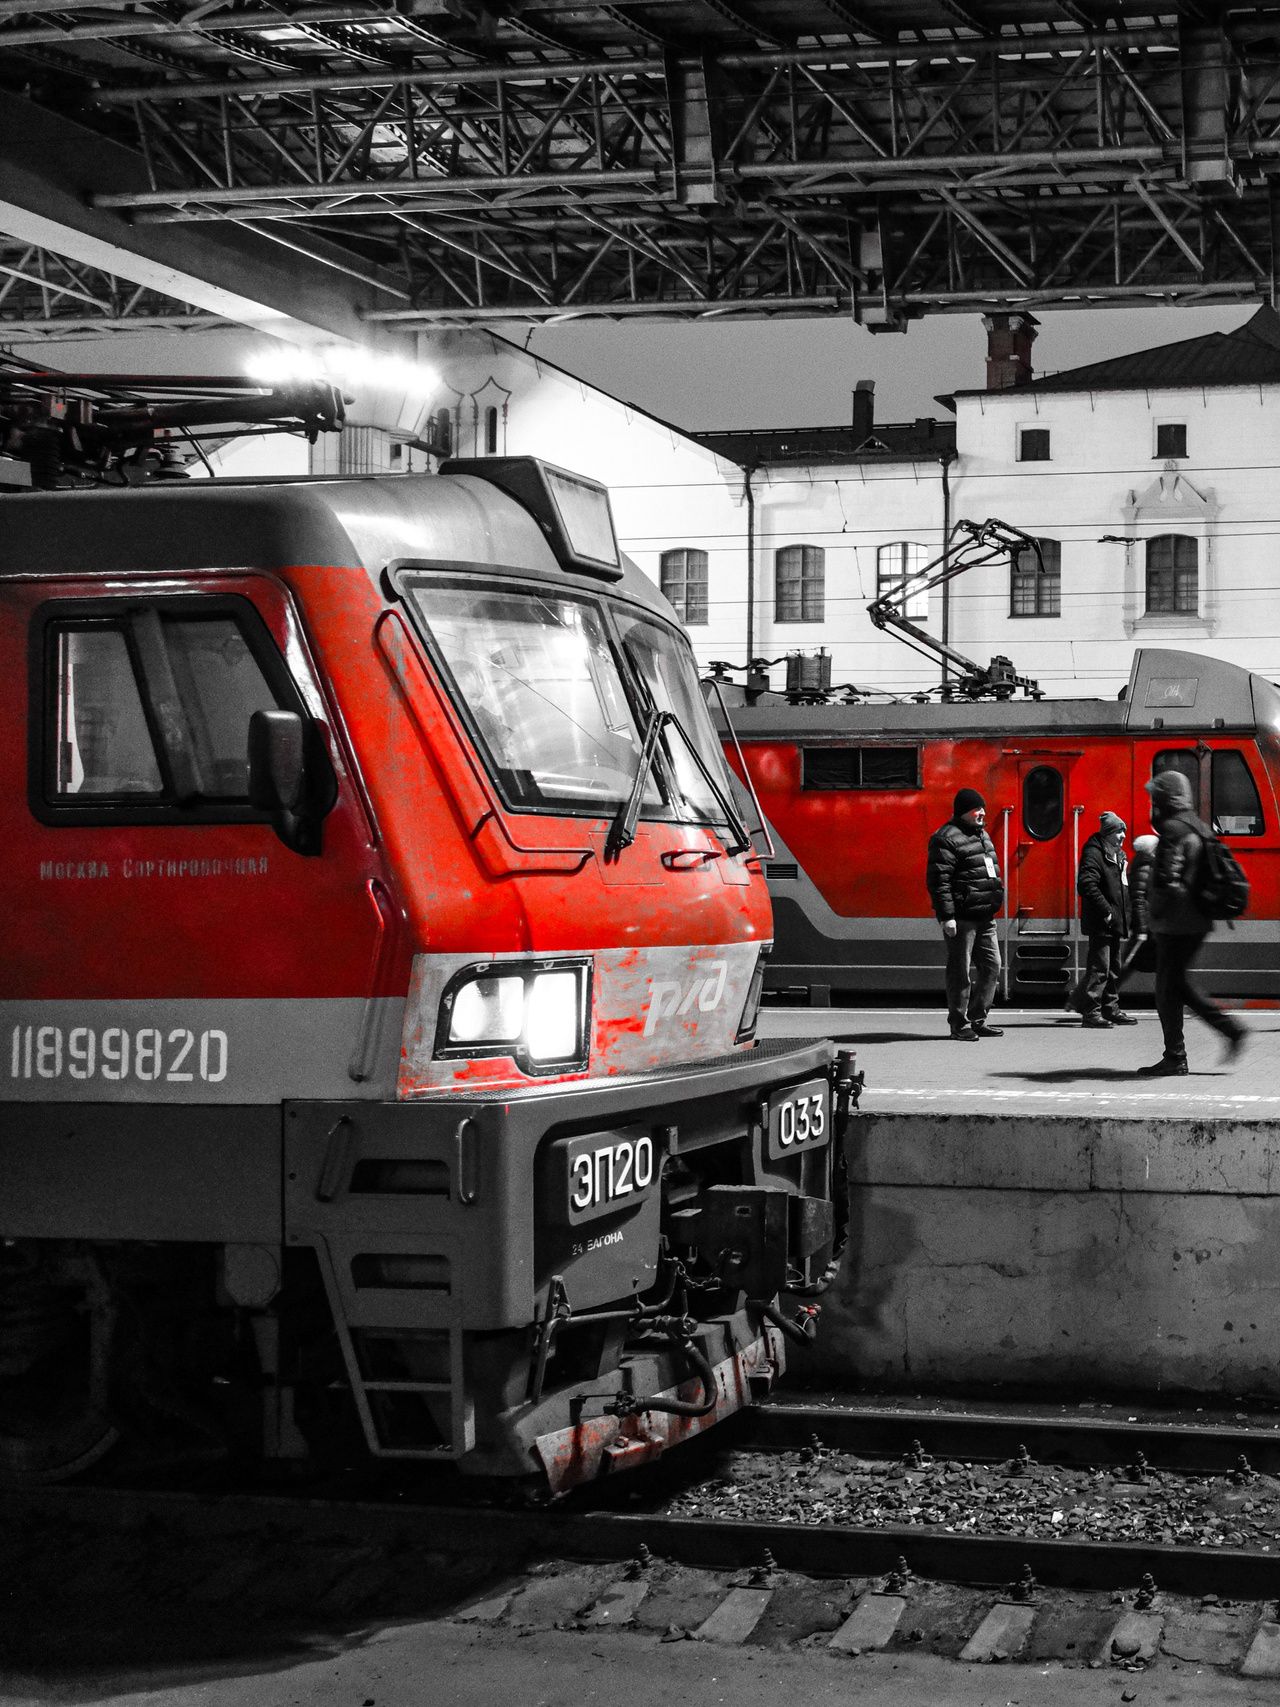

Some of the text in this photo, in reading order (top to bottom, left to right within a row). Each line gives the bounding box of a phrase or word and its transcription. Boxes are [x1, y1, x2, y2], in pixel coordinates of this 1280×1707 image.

[11, 1025, 228, 1082] 11899820
[780, 1094, 825, 1145] 033
[573, 1136, 653, 1207] ЭП20
